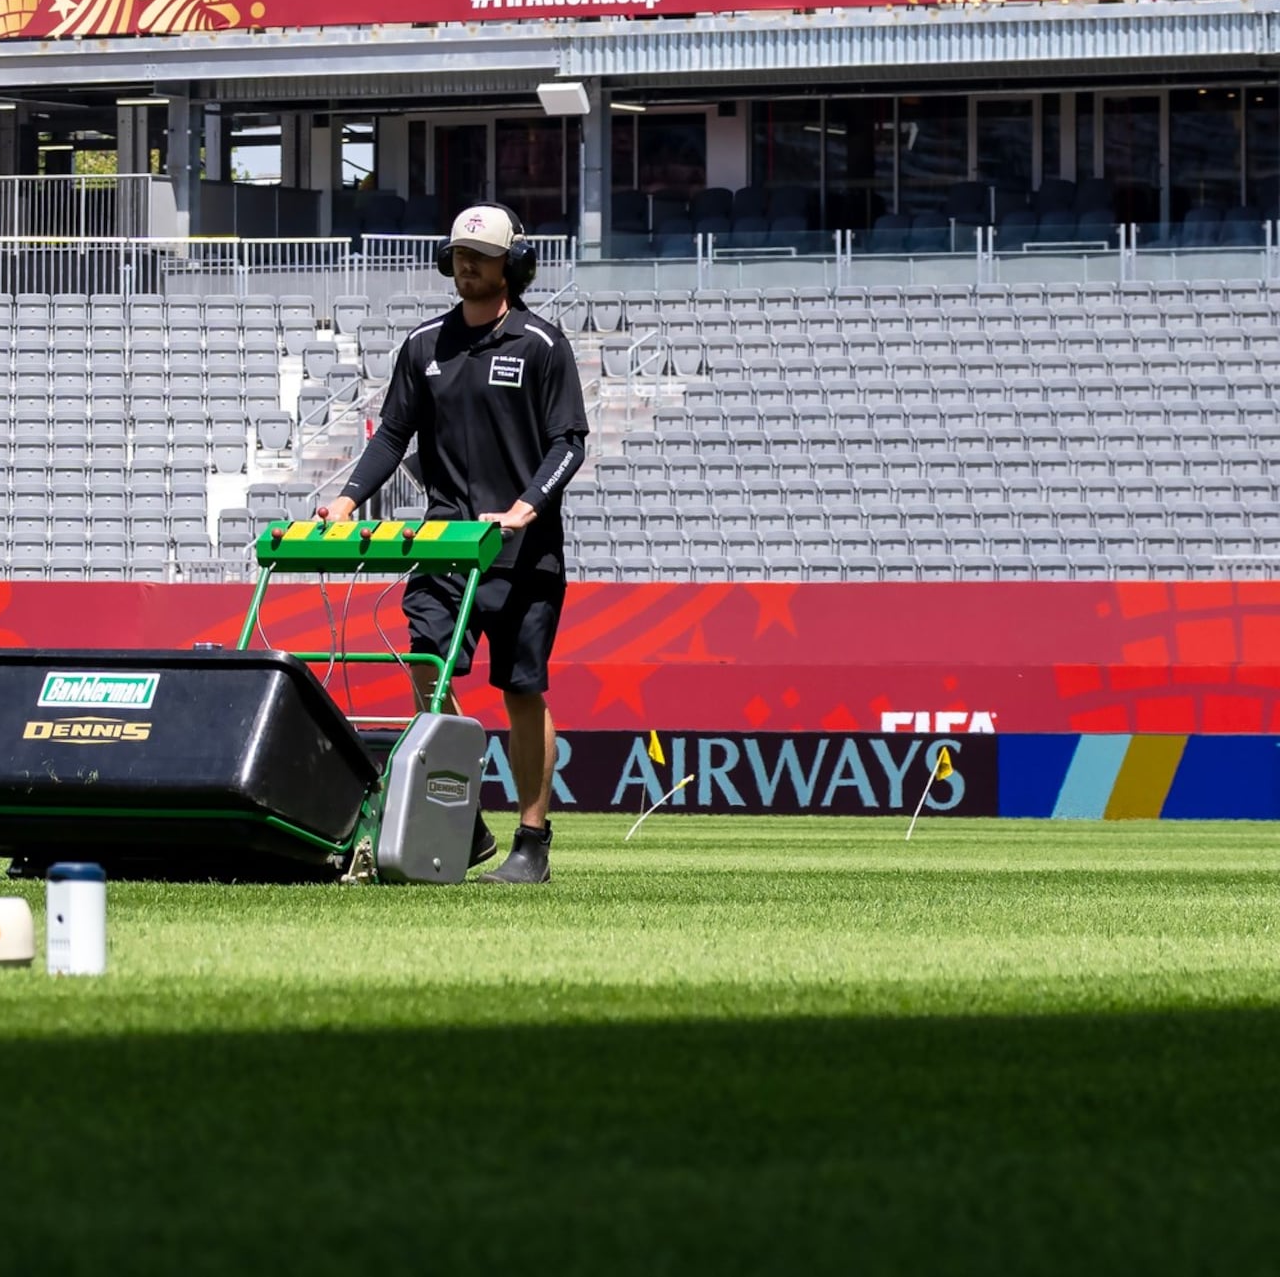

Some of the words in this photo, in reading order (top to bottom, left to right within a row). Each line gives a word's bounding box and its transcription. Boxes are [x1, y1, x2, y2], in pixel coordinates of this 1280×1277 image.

[23, 722, 152, 740] DENNIS
[611, 736, 966, 810] AIRWAYS
[428, 779, 465, 796] DENNIS
